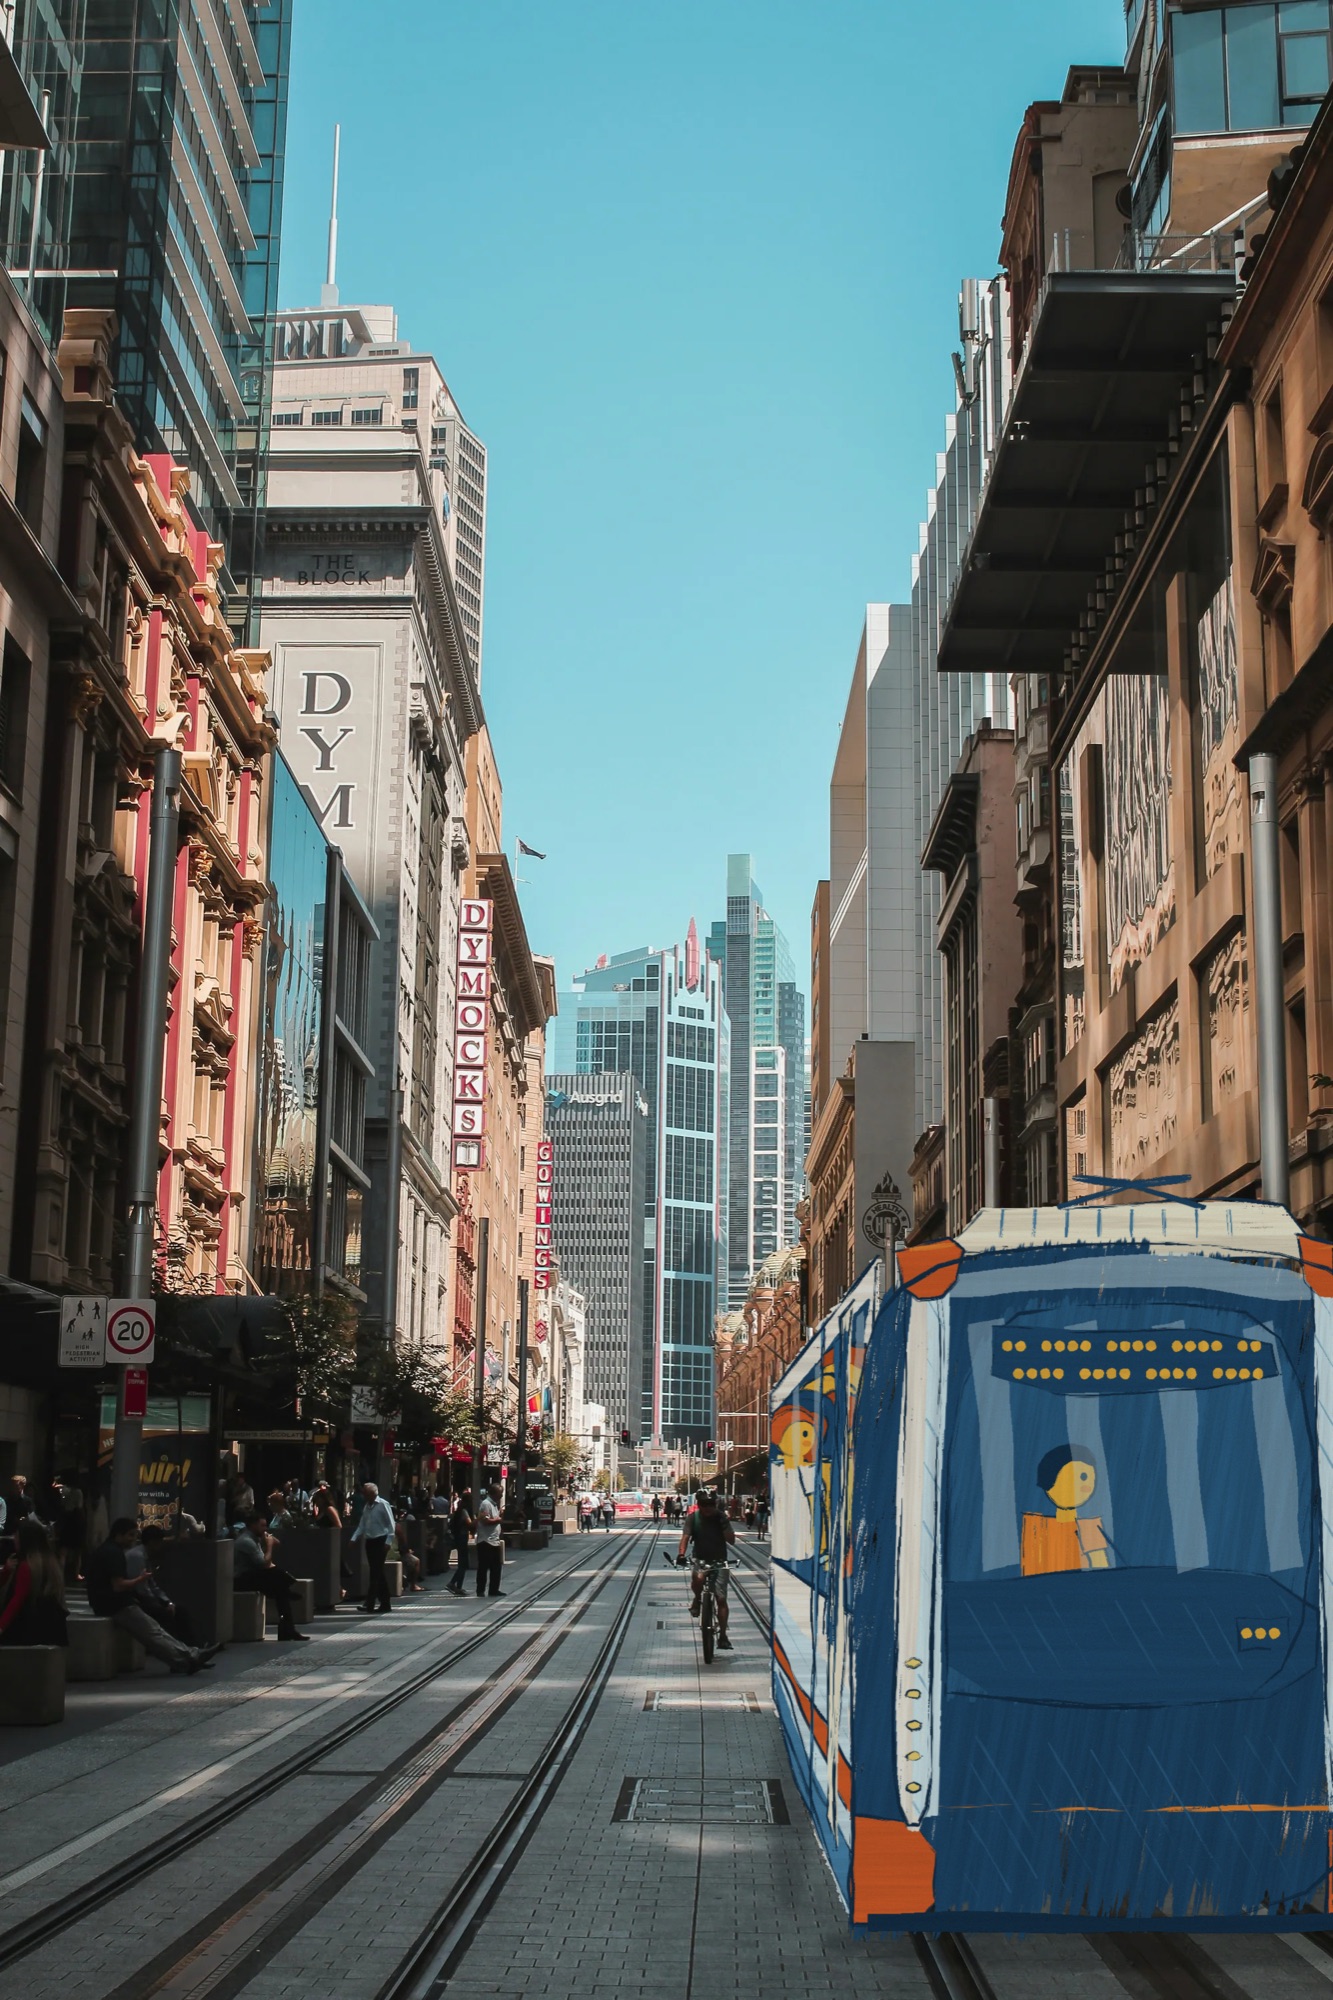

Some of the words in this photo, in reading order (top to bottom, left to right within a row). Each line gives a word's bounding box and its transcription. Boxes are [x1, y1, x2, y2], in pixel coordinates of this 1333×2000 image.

[312, 555, 354, 570] THE
[298, 571, 371, 586] BLOCK
[458, 904, 486, 1132] DYMOCKS
[569, 1090, 623, 1107] Ausgrid
[536, 1145, 551, 1288] GOWINGS
[871, 1204, 902, 1215] HEALTH
[865, 1224, 881, 1244] CARE
[117, 1321, 144, 1341] 20
[102, 1437, 114, 1448] NE
